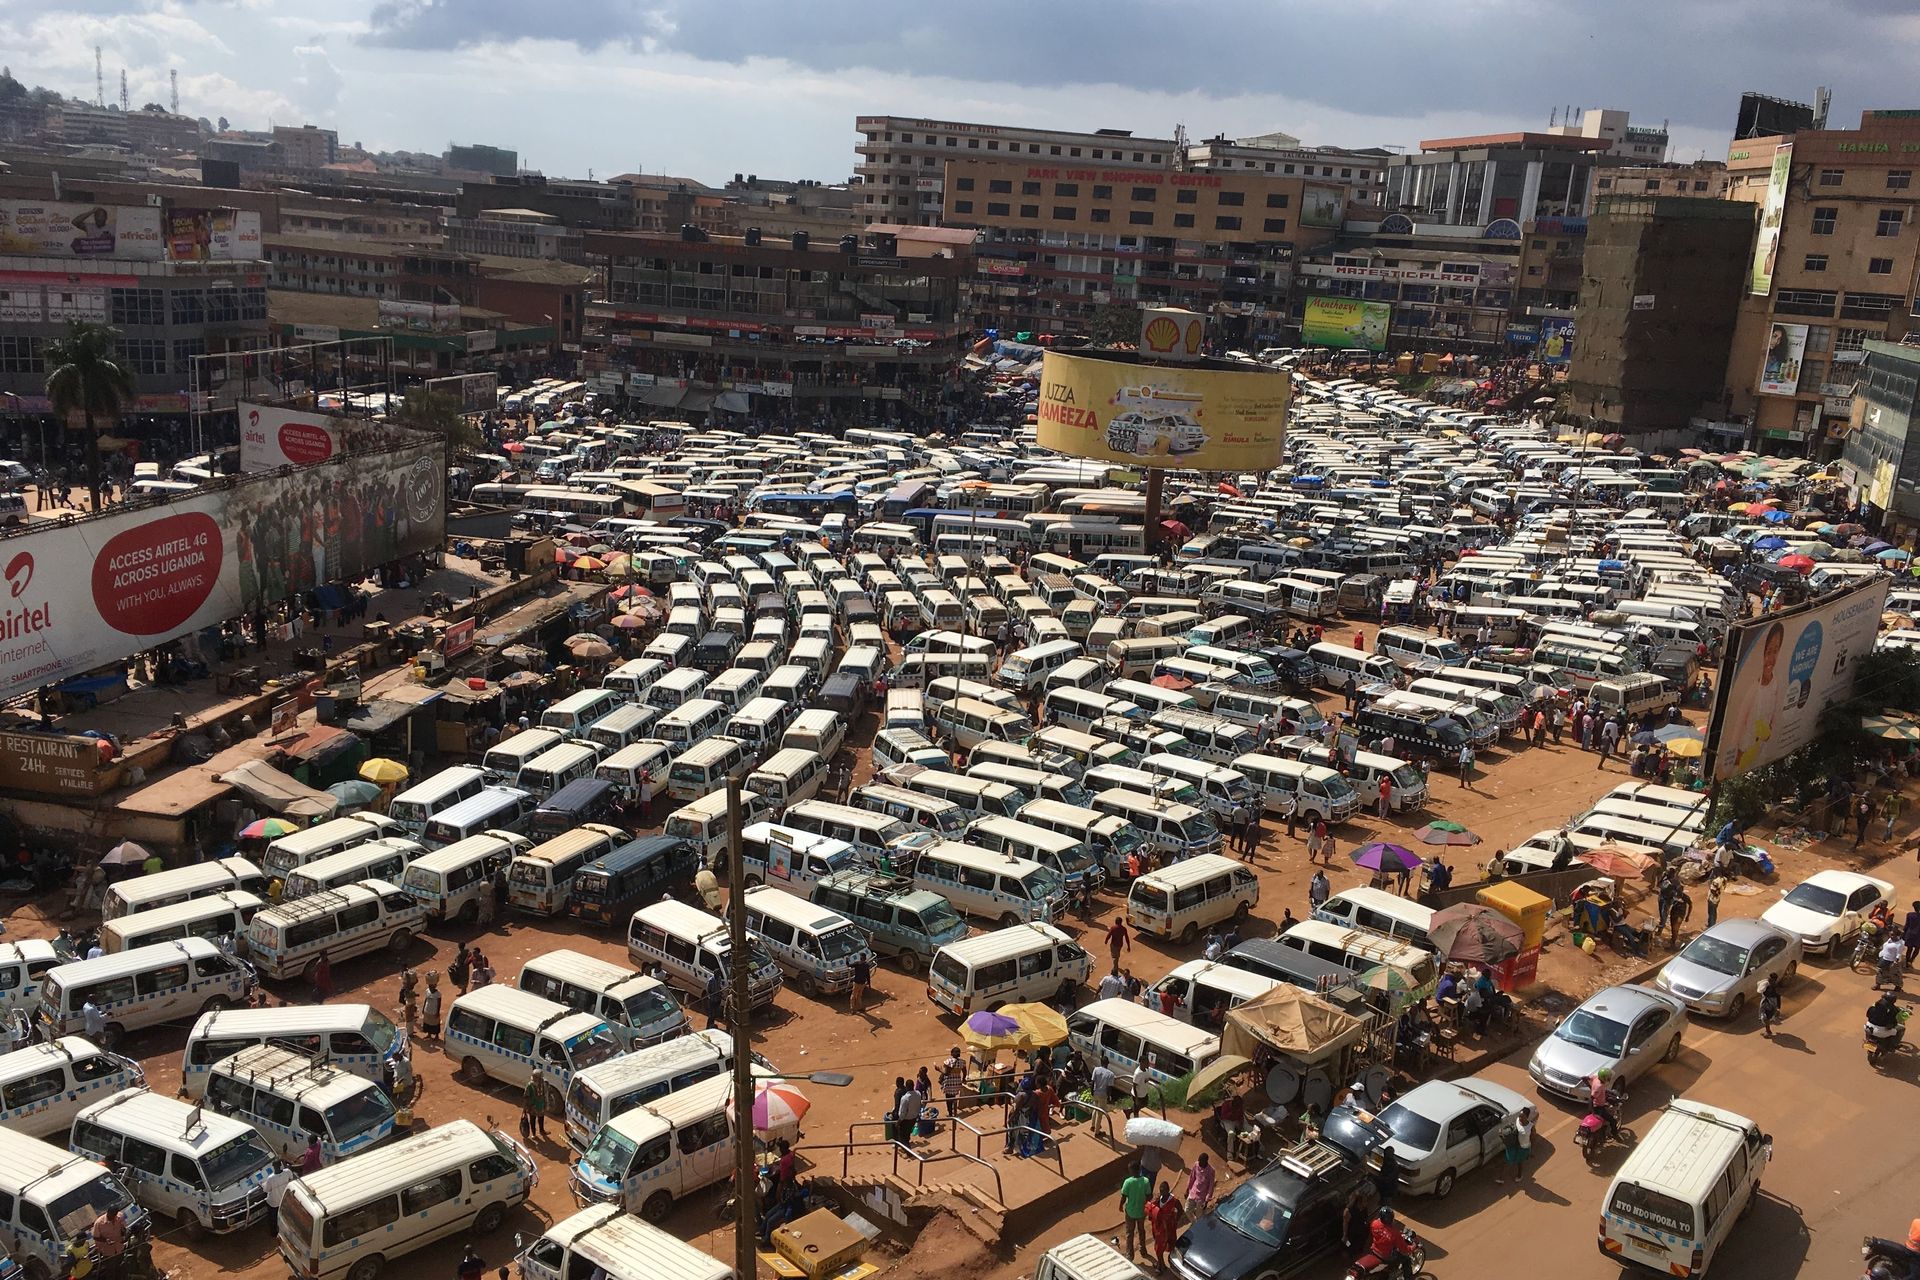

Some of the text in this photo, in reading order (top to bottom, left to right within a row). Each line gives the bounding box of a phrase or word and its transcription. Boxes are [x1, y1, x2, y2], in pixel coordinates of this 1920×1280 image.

[1027, 168, 1222, 188] PARK VIEW SHOPPING CENTRE
[1420, 272, 1474, 282] PLAZA
[1308, 297, 1358, 314] Menthozyl
[1044, 382, 1075, 404] JUZZA
[1039, 400, 1098, 431] KAMEEZA
[245, 430, 266, 444] airtel
[416, 459, 432, 472] SITES
[109, 532, 208, 572] ACCESS AIRTEL 4G
[113, 551, 204, 588] ACROSS UGANDA
[116, 593, 142, 612] WITH
[11, 659, 62, 684] SMARTPHONE
[6, 737, 80, 759] RESTAURANT
[20, 757, 86, 778] 24Hr. SERVICES
[60, 780, 94, 790] AVAILABLE
[820, 932, 836, 940] WHY
[1679, 1222, 1690, 1232] YO
